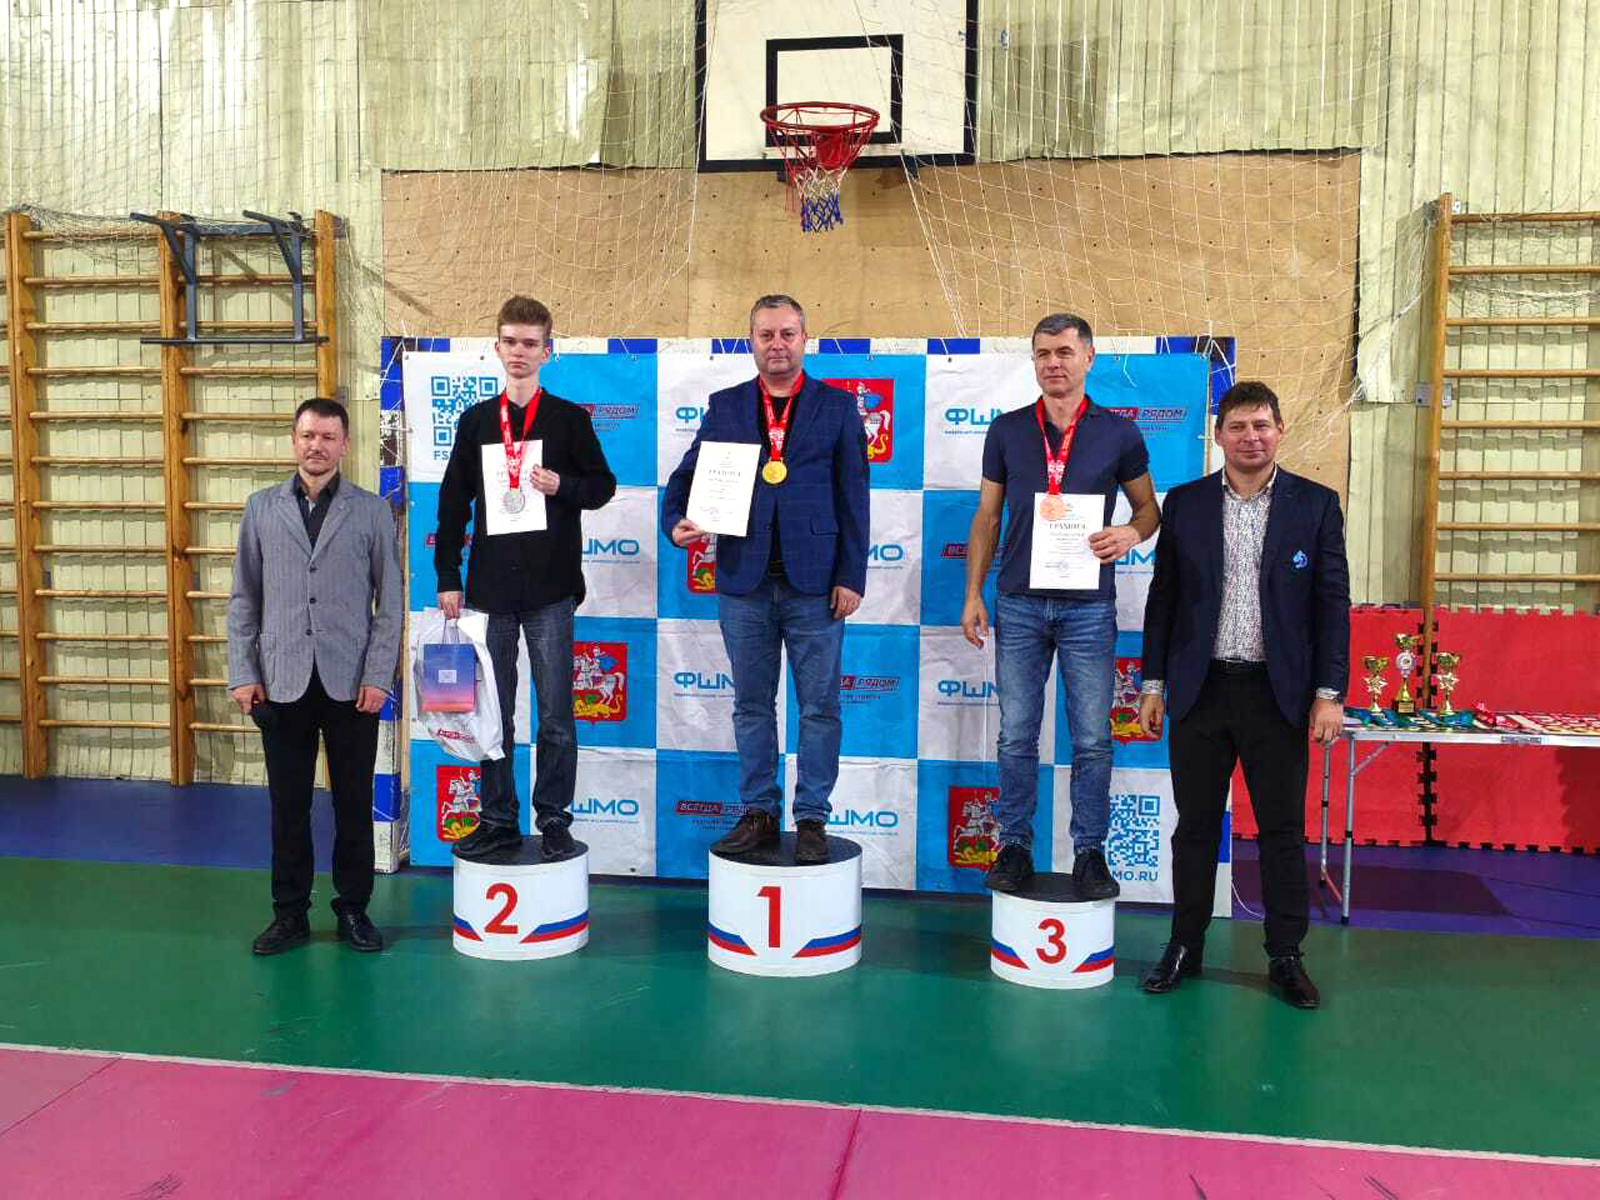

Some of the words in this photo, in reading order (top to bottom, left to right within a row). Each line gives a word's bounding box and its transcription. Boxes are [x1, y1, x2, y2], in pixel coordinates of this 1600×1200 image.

[945, 408, 1002, 425] ФШ
[571, 798, 639, 815] ШМО
[827, 810, 898, 827] ШМО
[1111, 871, 1158, 882] MO.RU
[484, 882, 519, 935] 2
[756, 885, 782, 948] 1
[1036, 918, 1067, 964] 3
